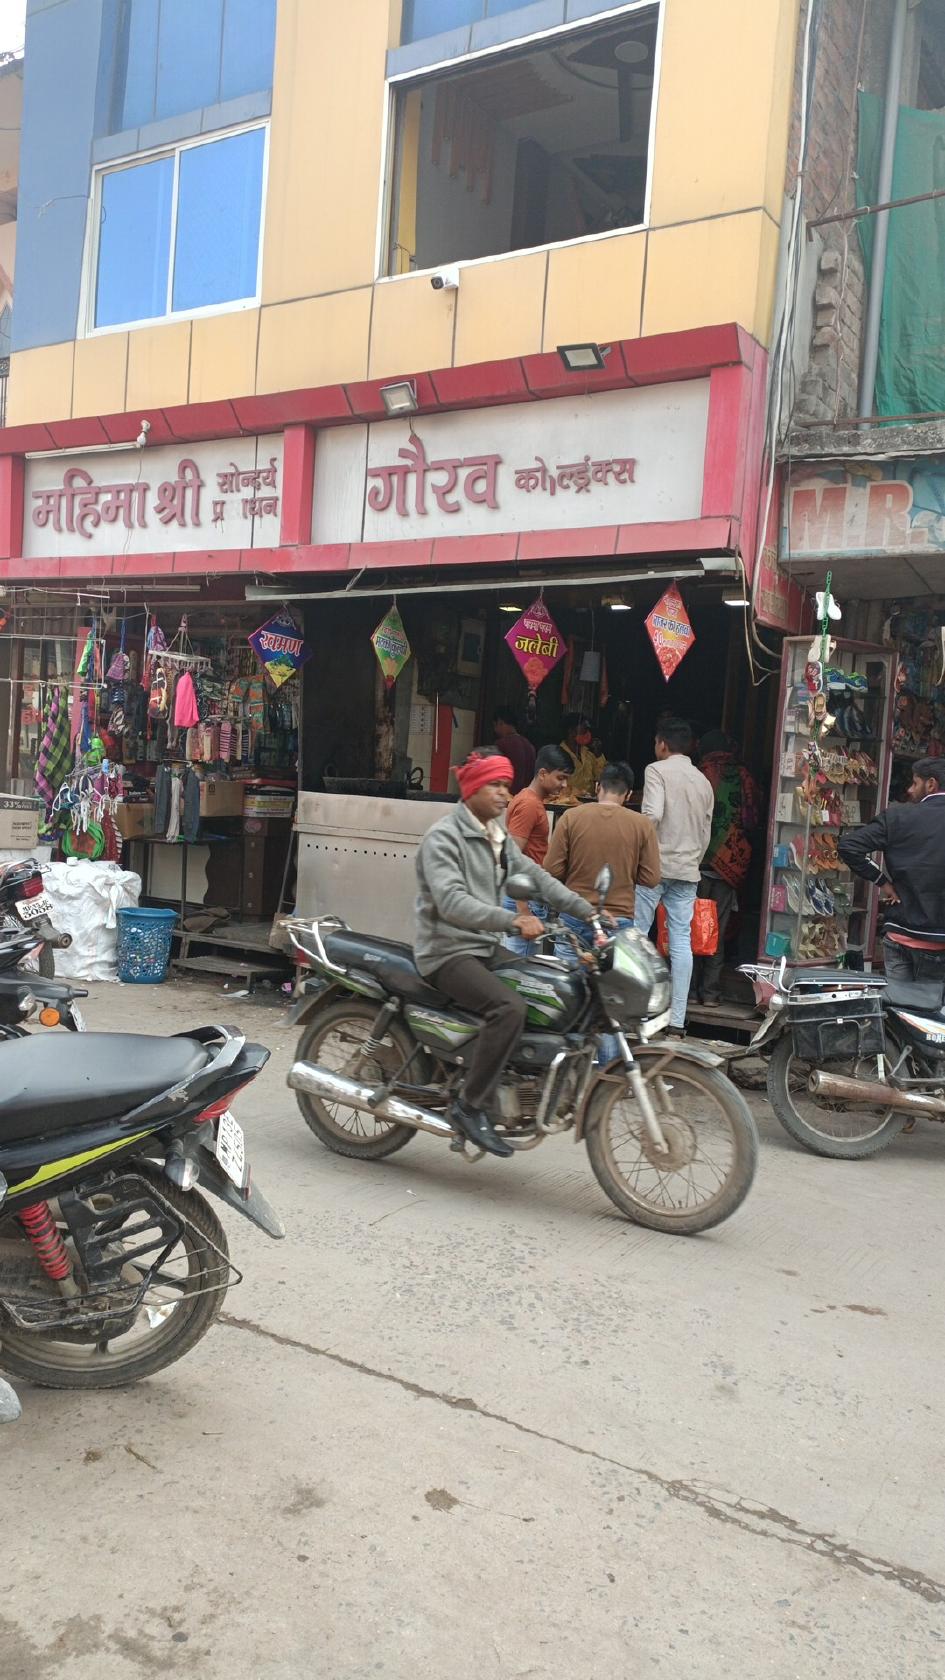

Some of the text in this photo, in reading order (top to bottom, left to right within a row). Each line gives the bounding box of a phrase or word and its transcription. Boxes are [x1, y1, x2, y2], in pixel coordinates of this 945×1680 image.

[31, 459, 205, 539] महिमा श्री
[367, 433, 502, 517] गौरव
[515, 633, 559, 657] जलेबी
[3, 800, 21, 809] 33%
